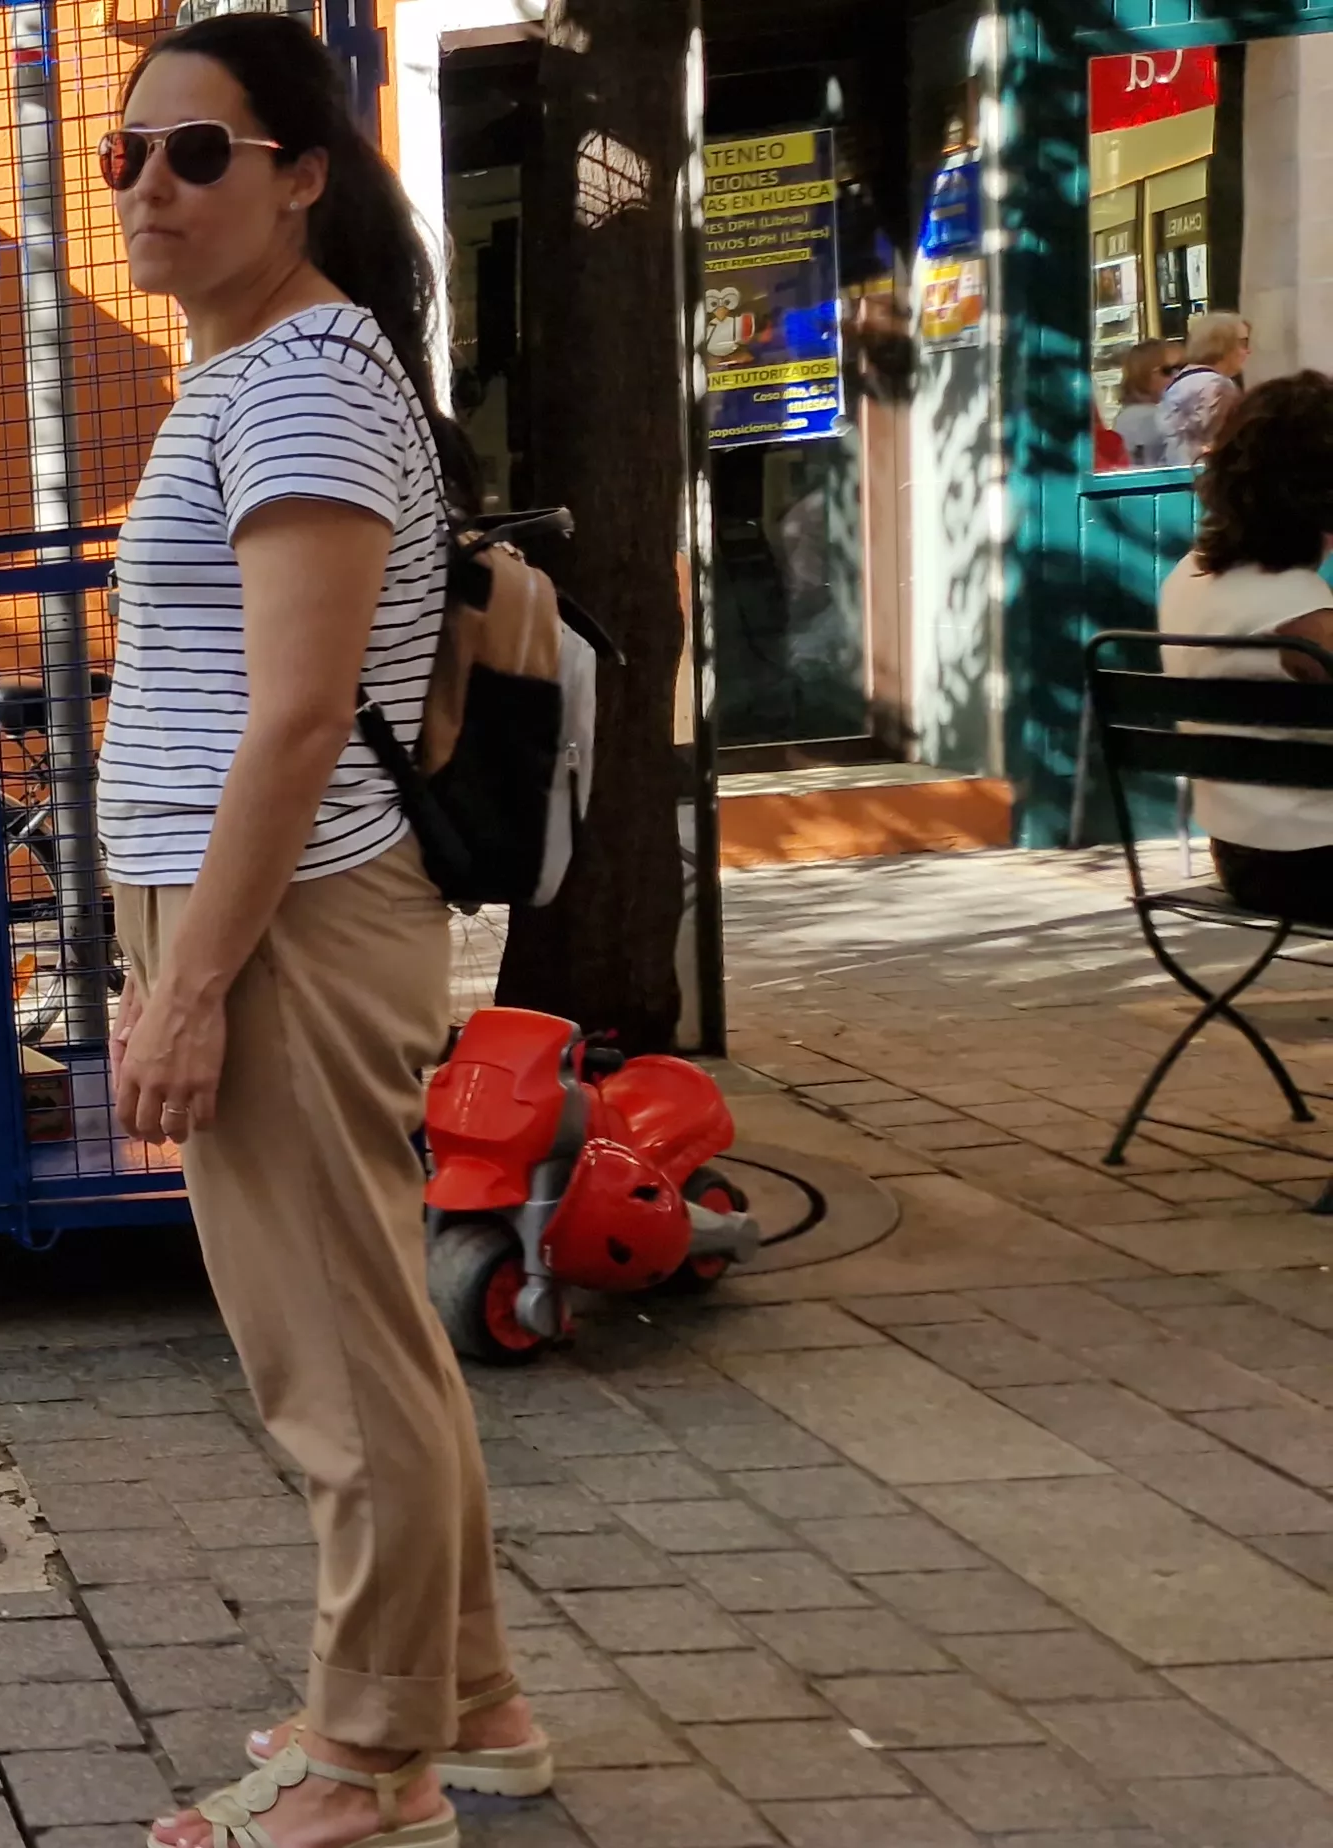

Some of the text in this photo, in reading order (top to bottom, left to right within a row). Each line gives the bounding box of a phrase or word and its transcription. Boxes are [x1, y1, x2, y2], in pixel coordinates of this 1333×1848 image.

[704, 142, 785, 168] TENEO
[733, 195, 754, 209] EN
[761, 184, 830, 206] HUESCA
